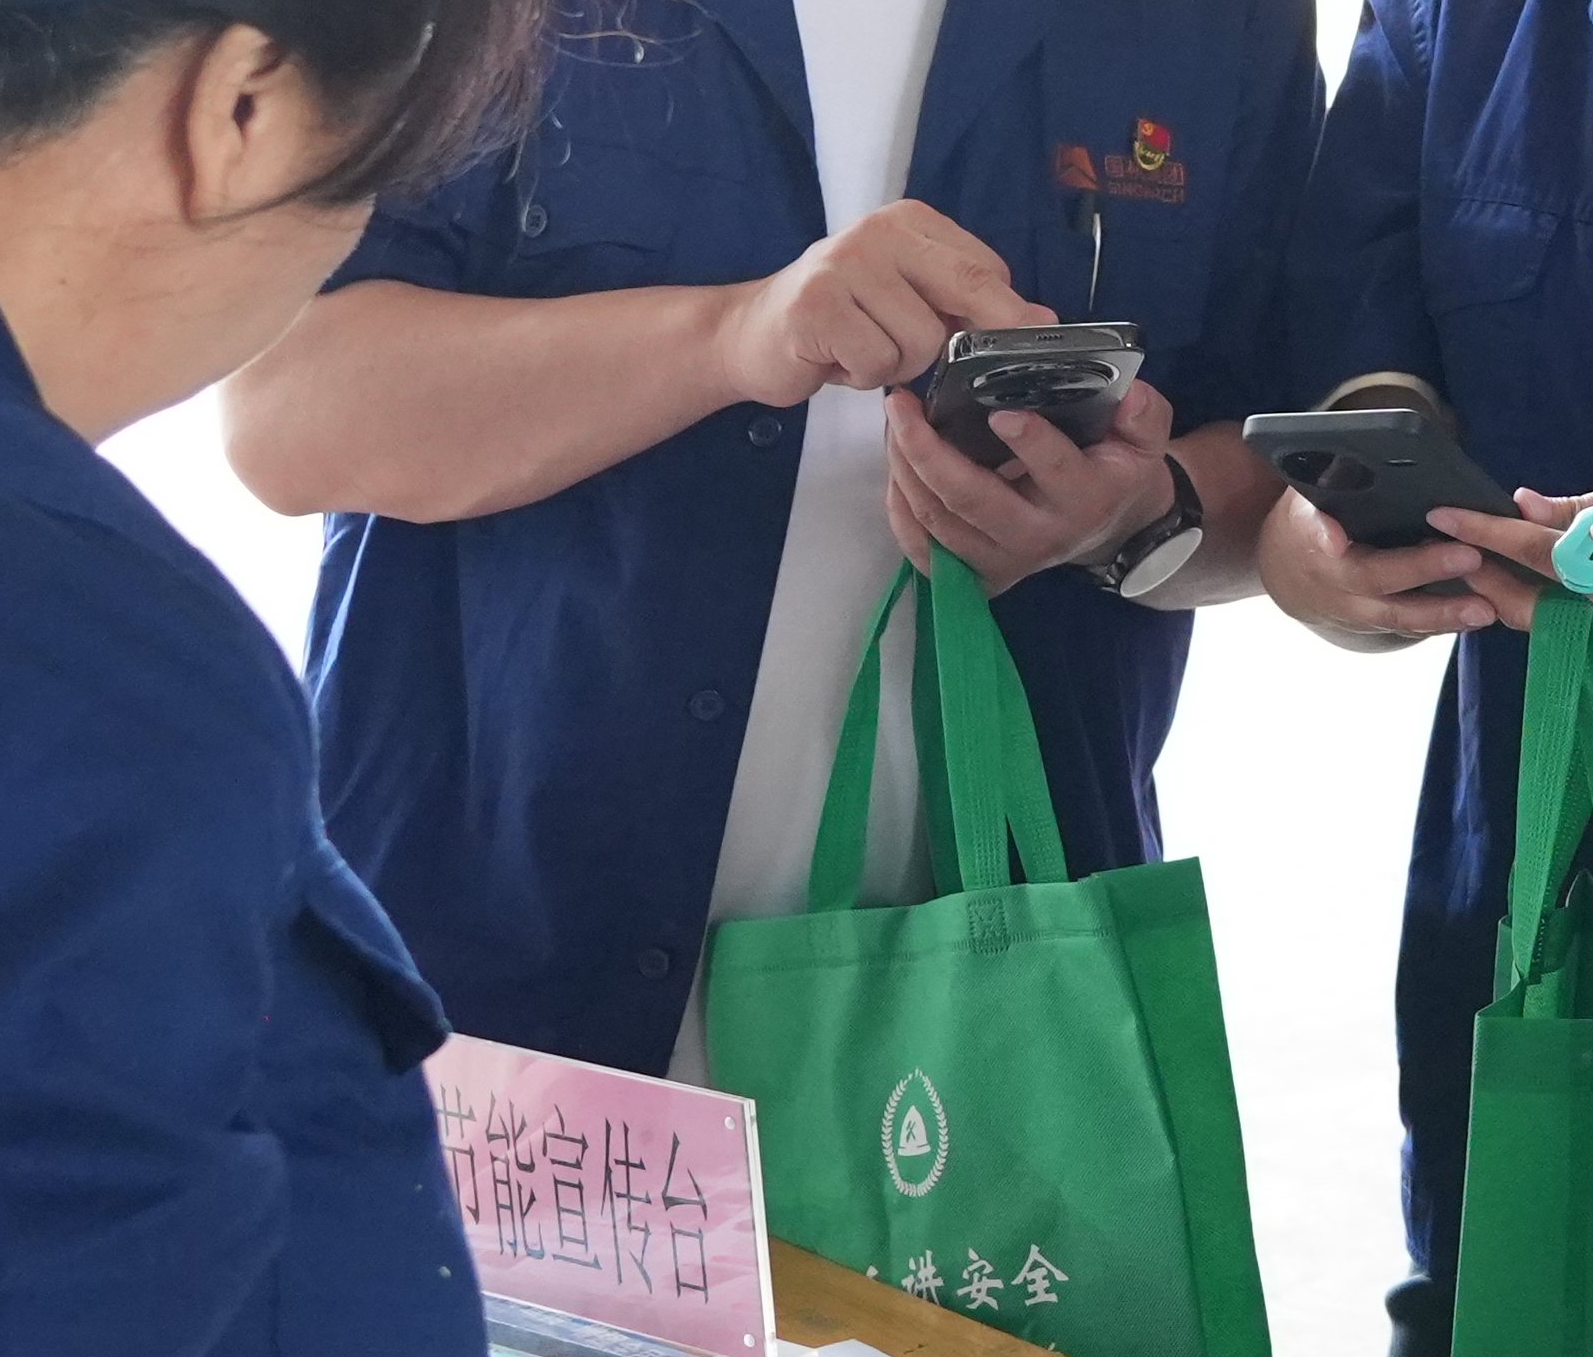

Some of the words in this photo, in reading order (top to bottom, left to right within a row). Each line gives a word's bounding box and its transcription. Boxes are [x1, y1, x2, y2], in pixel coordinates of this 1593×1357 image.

[438, 1081, 709, 1305] 节能宣传台
[864, 1244, 1070, 1311] 讲安全
